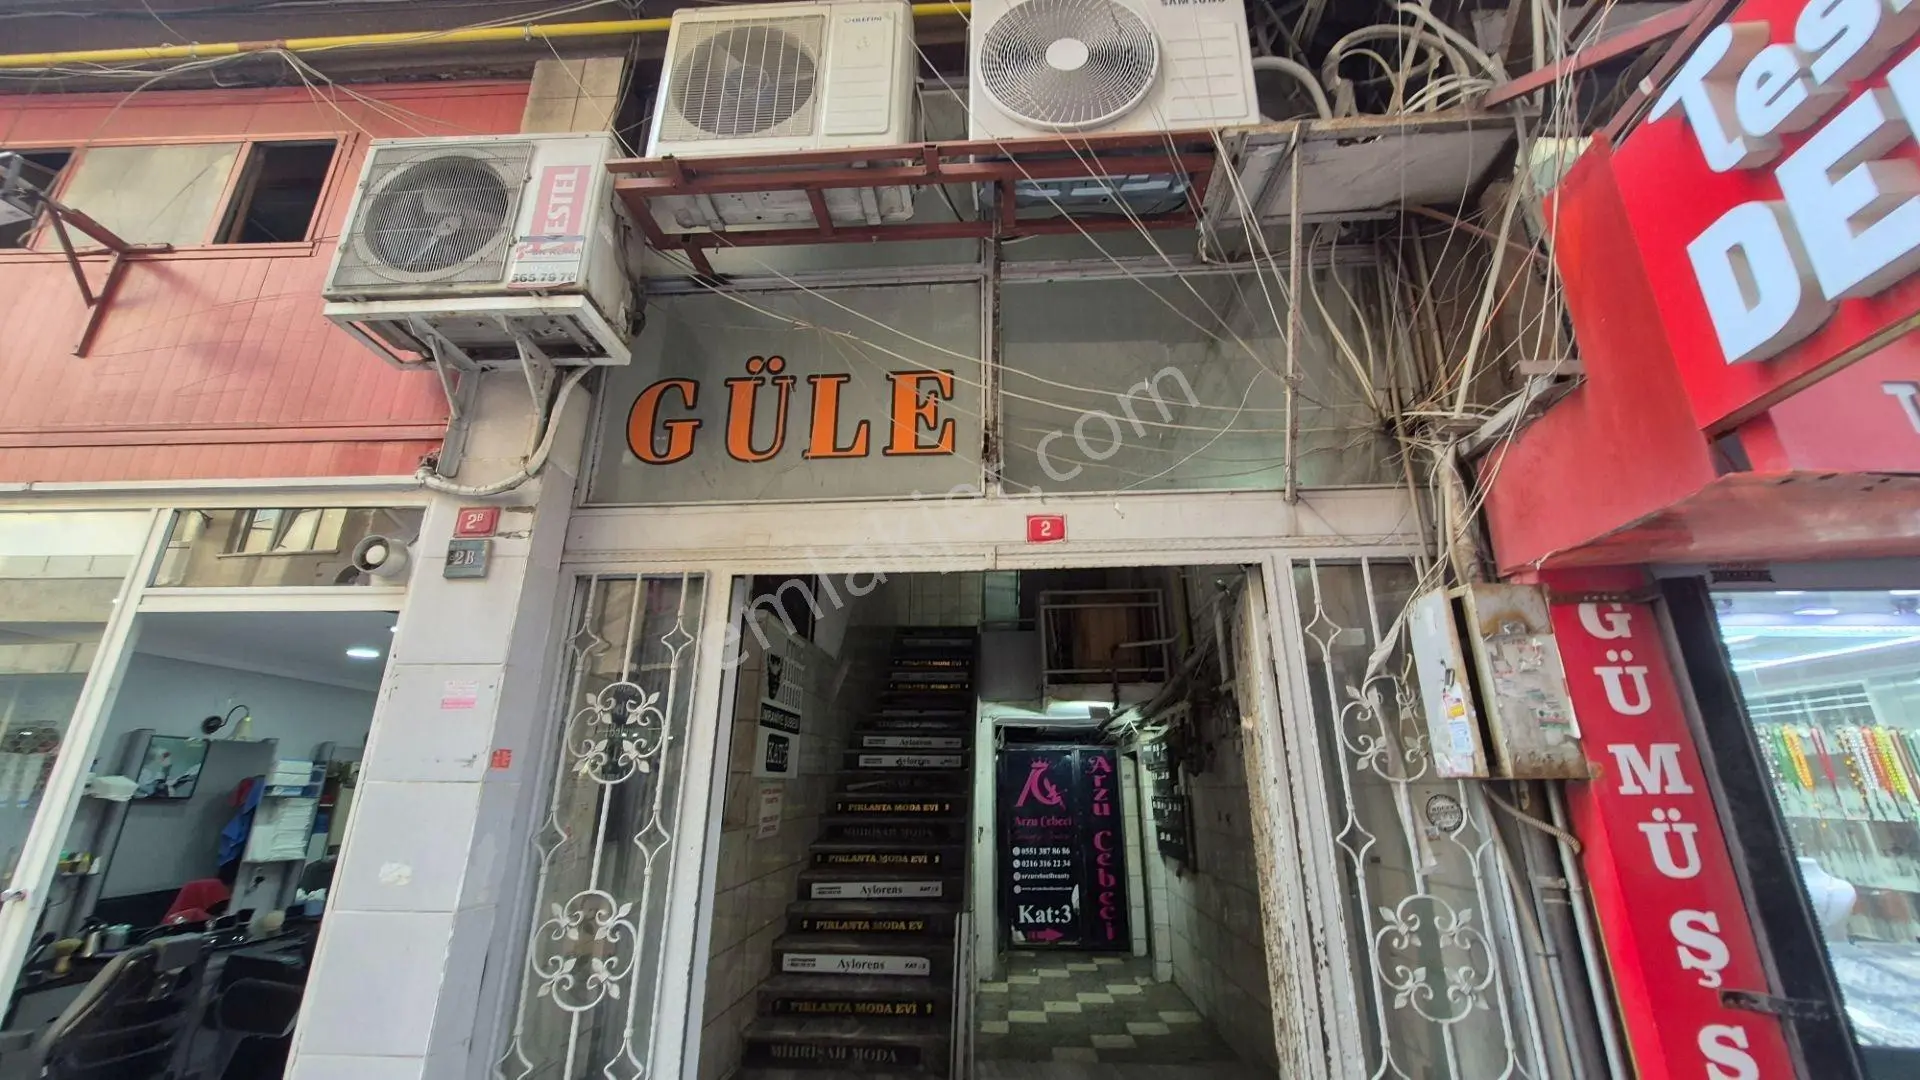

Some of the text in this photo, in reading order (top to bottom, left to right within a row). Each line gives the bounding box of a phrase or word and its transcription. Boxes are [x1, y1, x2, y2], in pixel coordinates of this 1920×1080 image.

[1648, 0, 1912, 173] Tes
[626, 356, 956, 465] GÜLE
[1041, 520, 1051, 536] 2
[894, 803, 920, 811] MODA
[1085, 755, 1116, 940] Arzu Cebeci
[861, 885, 903, 897] Aylorens
[1018, 904, 1072, 924] Kat:3
[837, 959, 885, 972] Aylorens
[855, 1002, 892, 1013] MODA
[852, 1046, 897, 1062] MODA
